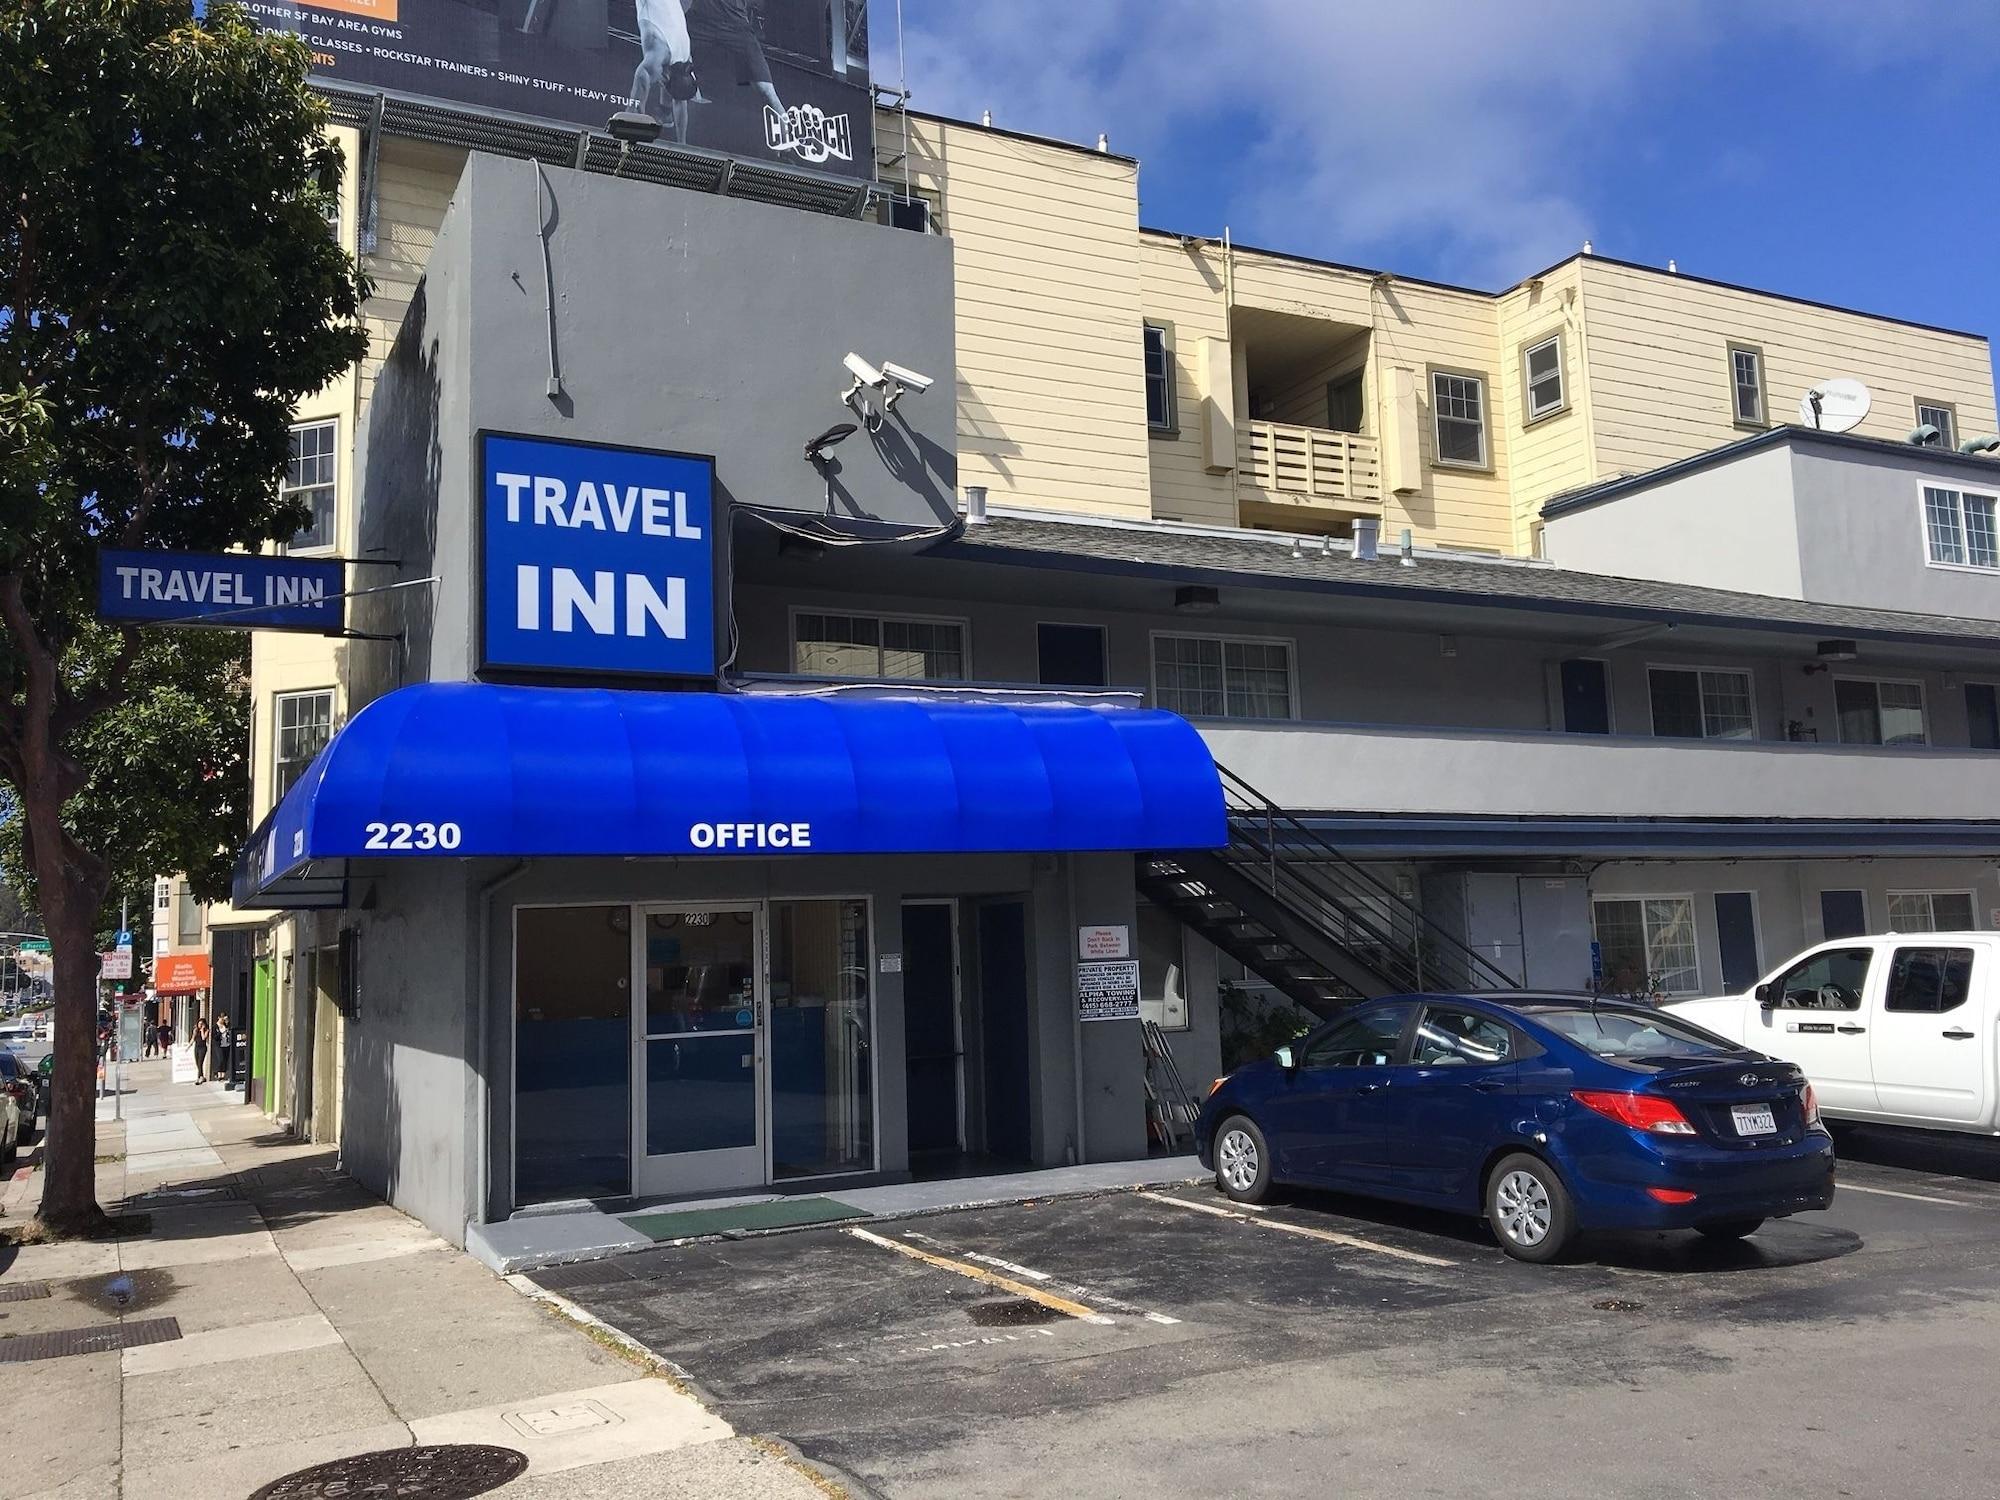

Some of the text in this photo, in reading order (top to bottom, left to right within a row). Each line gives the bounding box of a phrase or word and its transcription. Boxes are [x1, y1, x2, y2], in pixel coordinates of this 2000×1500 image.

[252, 4, 291, 18] OTHER
[294, 11, 309, 21] SF
[311, 14, 334, 26] BAY
[337, 19, 368, 33] AREA
[371, 26, 403, 39] GYMS
[311, 36, 363, 53] CLASSES
[373, 47, 432, 67] ROCKSTAR
[434, 58, 488, 77] TRAINERS
[498, 71, 530, 86] SHINY
[532, 78, 565, 93] STUFF
[574, 87, 607, 101] HEAVY
[610, 94, 641, 108] STUFF
[763, 104, 853, 162] CRUNCH
[496, 472, 702, 540] TRAVEL
[116, 566, 324, 609] TRAVEL INN
[517, 565, 686, 640] INN
[364, 822, 462, 850] 2230
[690, 823, 811, 848] OFFICE
[684, 912, 709, 926] 2230
[119, 931, 130, 944] P
[1736, 1113, 1775, 1131] 7TYM322
